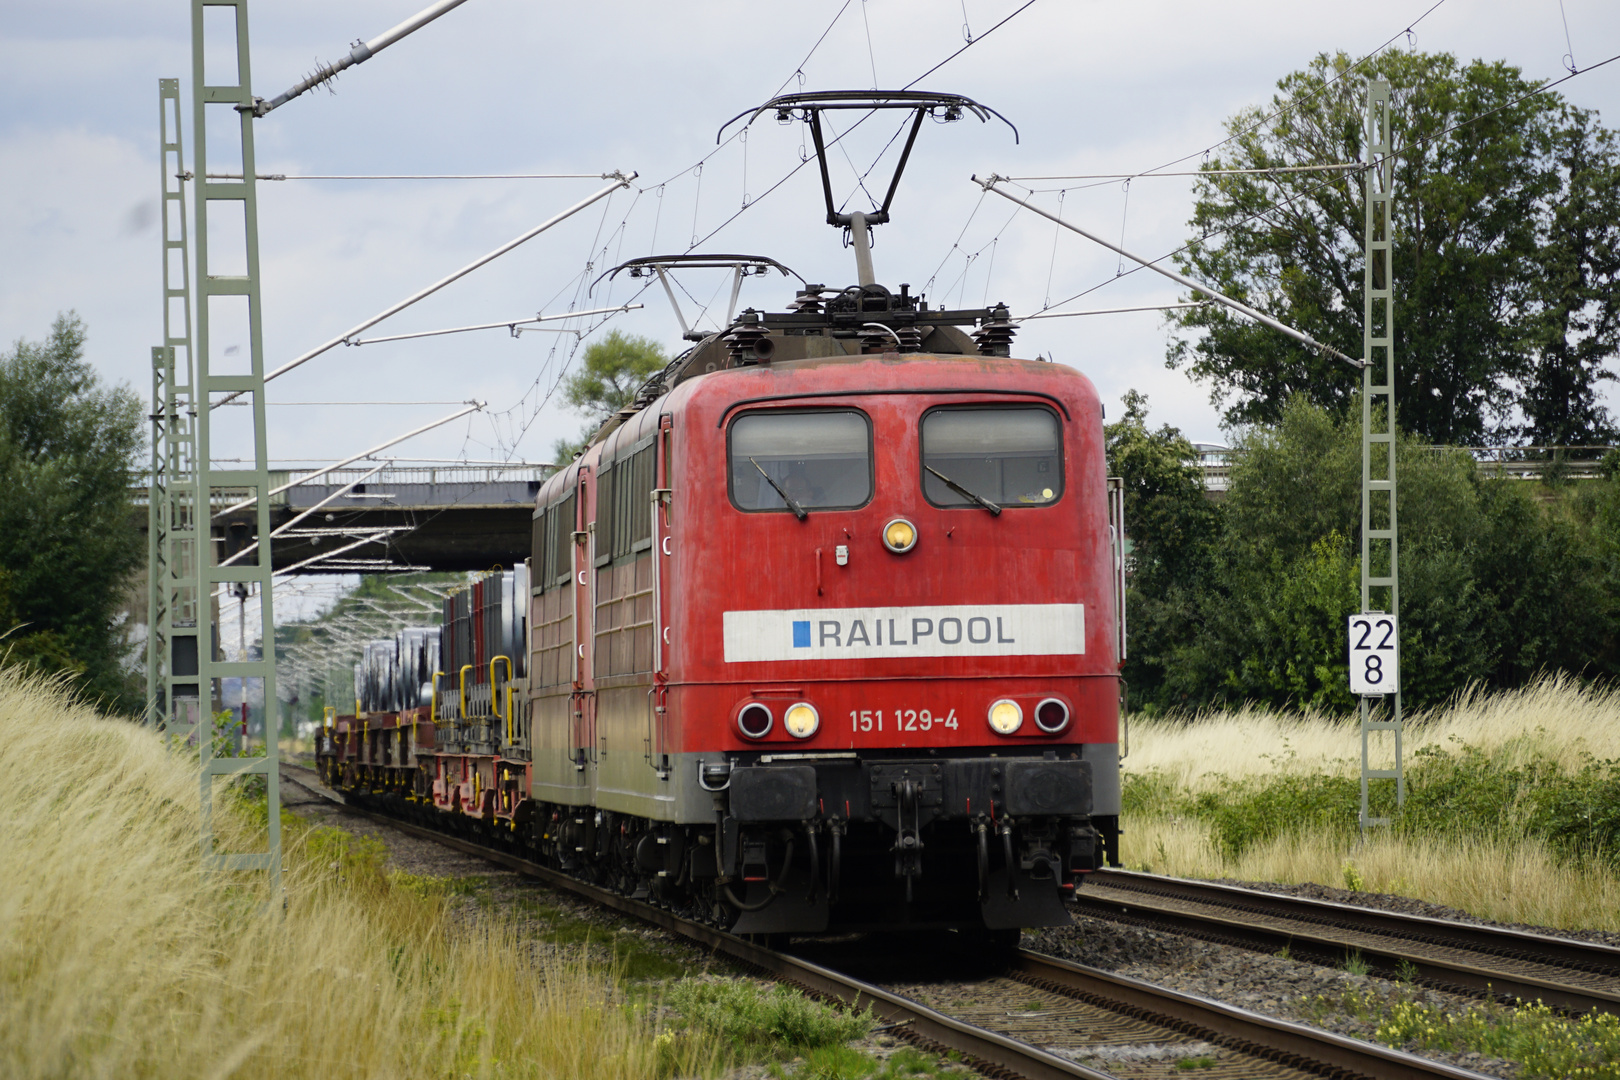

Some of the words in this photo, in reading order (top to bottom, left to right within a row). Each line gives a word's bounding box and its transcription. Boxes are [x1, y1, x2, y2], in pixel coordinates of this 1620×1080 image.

[818, 616, 1015, 647] RAILPOOL
[1352, 619, 1394, 650] 22
[1364, 654, 1383, 685] 8
[849, 710, 883, 732] 151
[894, 708, 959, 731] 129-4
